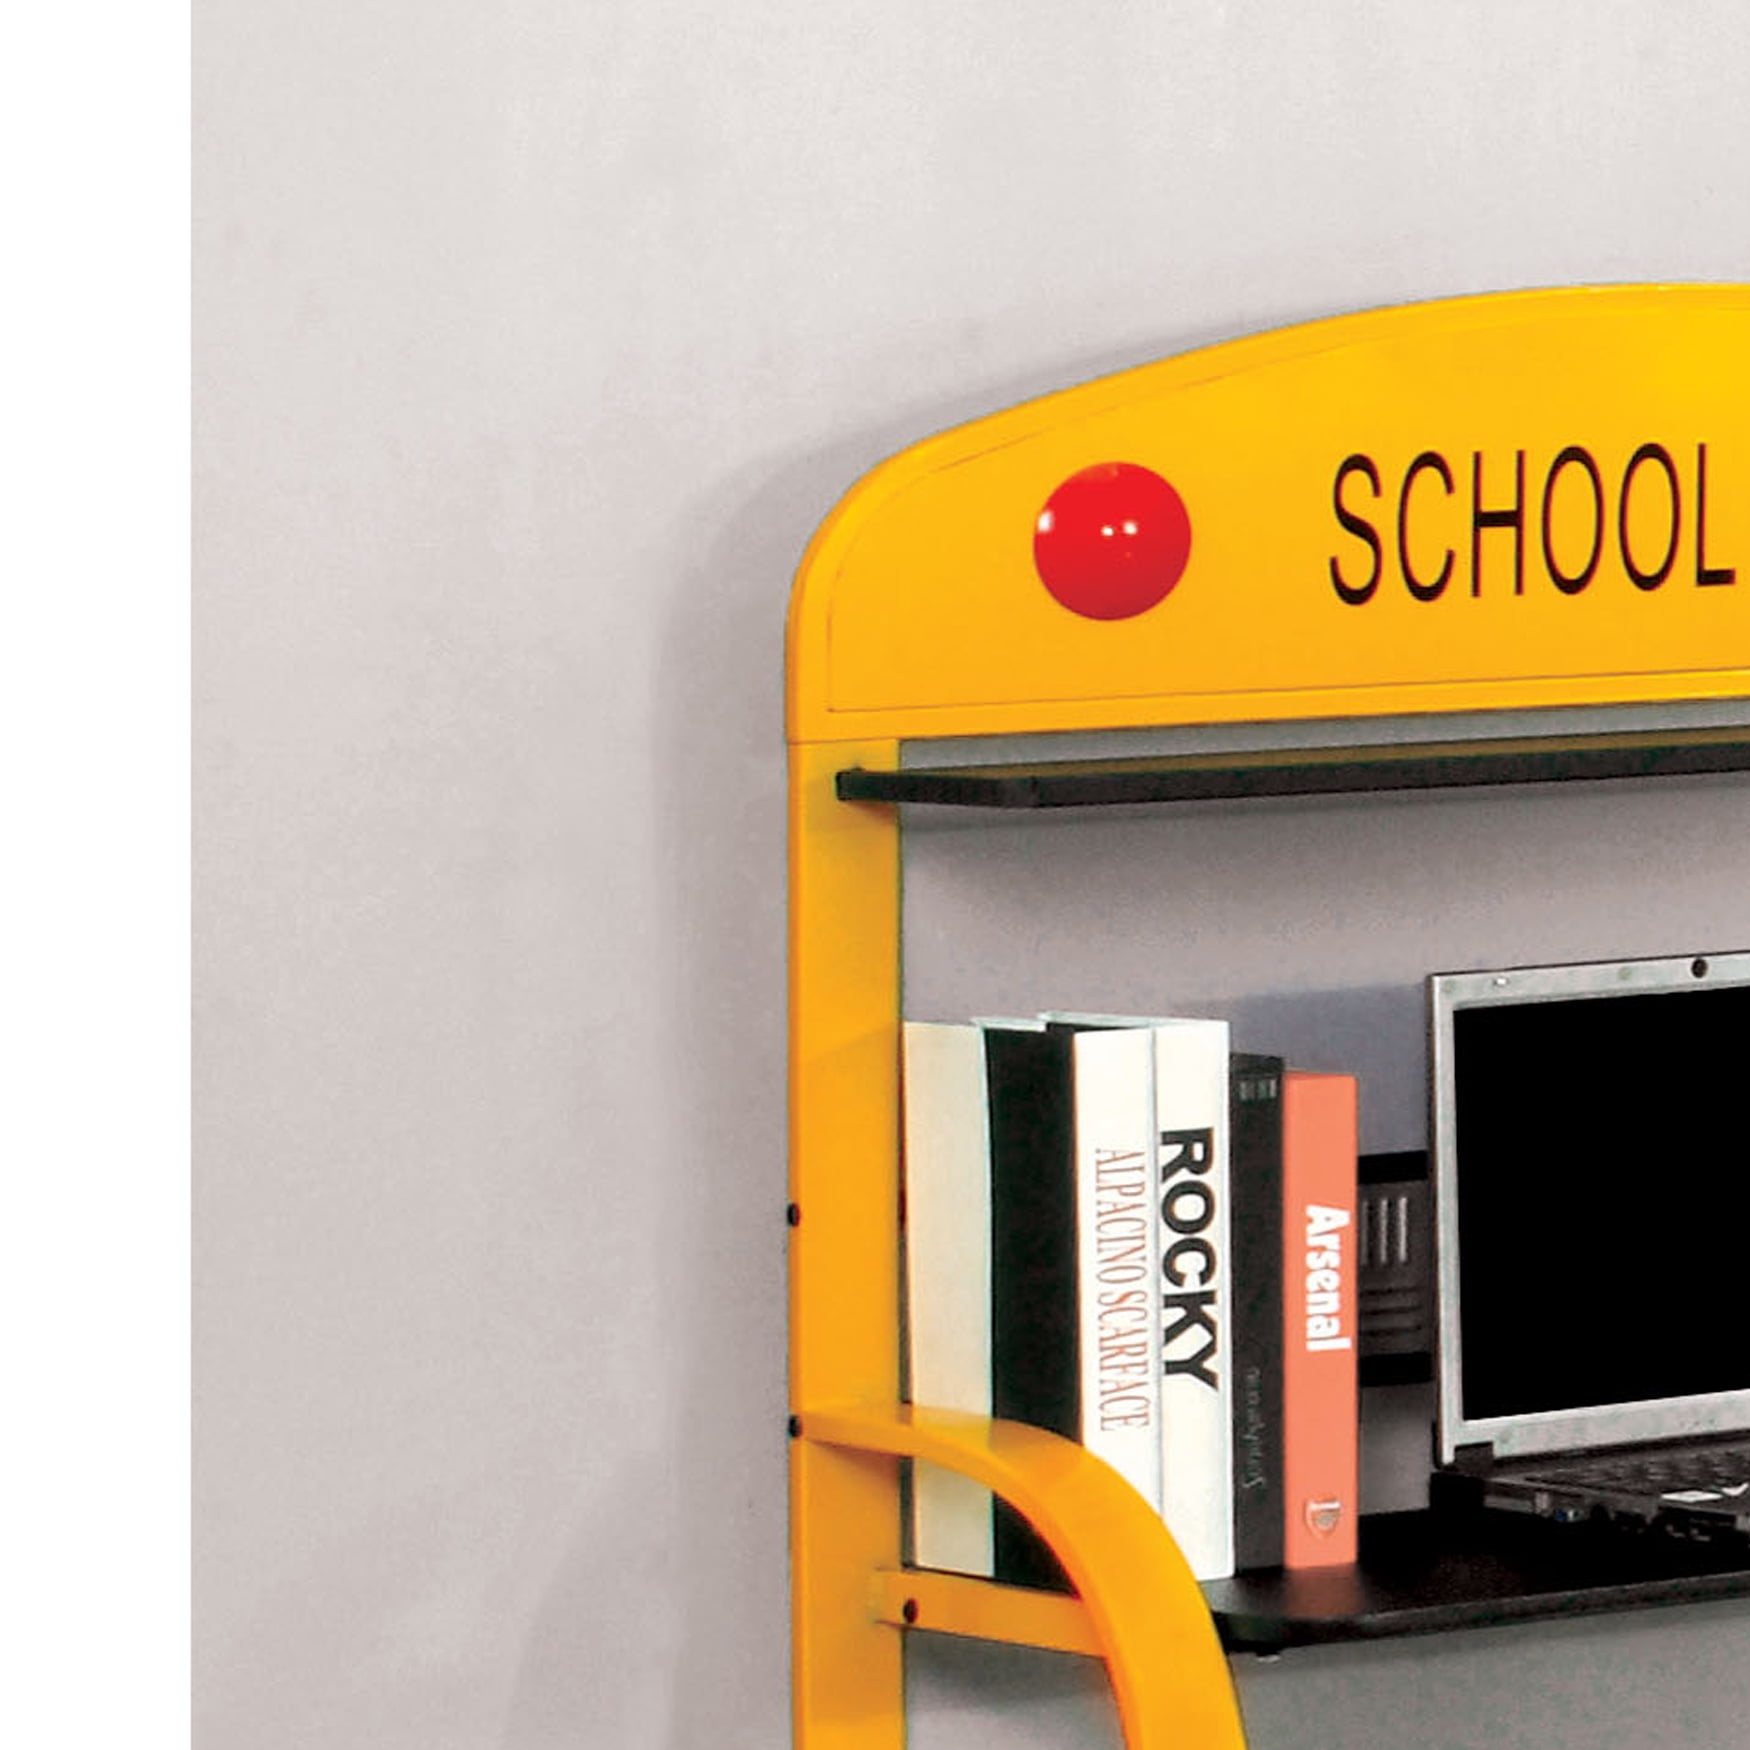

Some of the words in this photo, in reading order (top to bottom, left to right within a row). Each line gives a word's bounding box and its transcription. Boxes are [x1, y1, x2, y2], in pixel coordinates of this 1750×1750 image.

[1330, 442, 1735, 606] SCHOOL
[1160, 1127, 1218, 1392] ROCKY
[1305, 1205, 1351, 1353] Arsenal
[1098, 1291, 1149, 1432] SCARFACE
